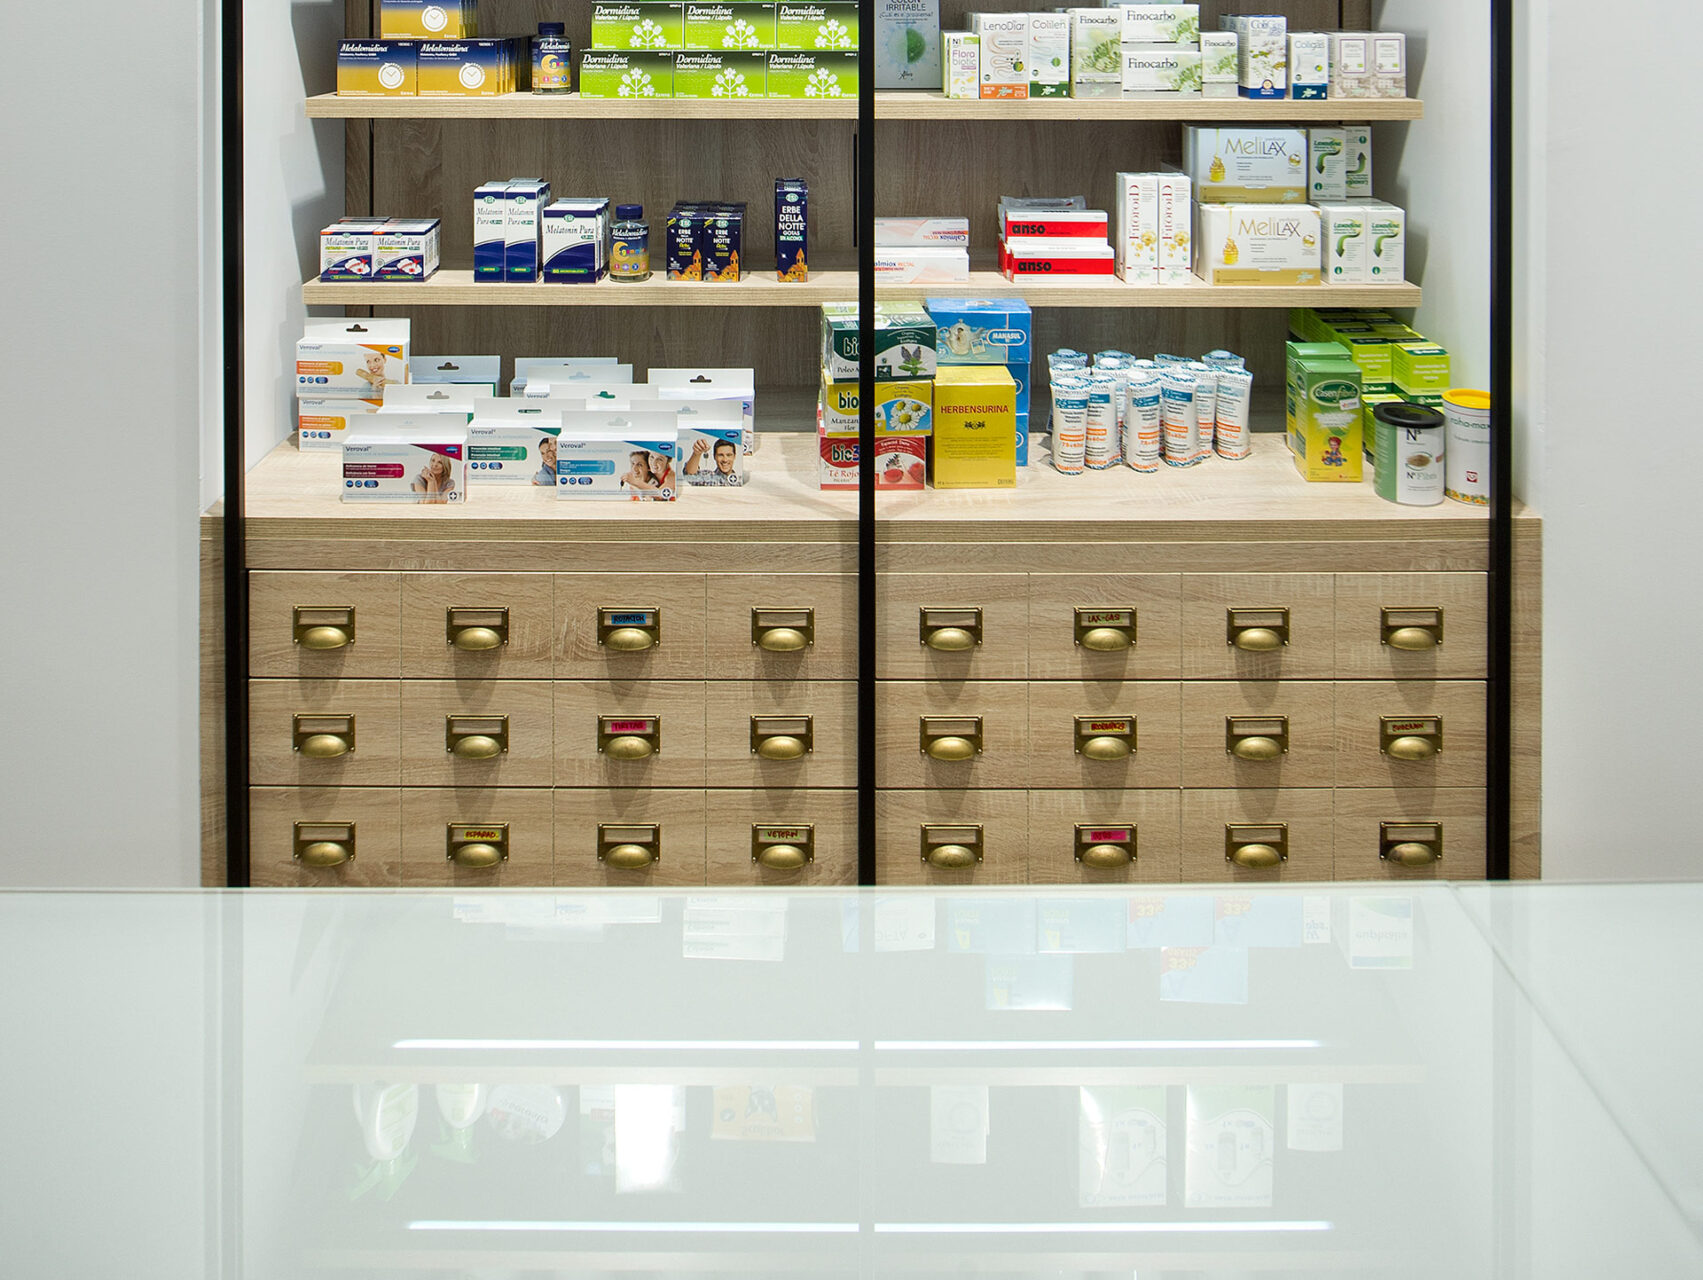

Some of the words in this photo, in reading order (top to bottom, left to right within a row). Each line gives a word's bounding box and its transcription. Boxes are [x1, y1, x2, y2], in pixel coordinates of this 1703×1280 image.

[595, 5, 640, 15] Dormidina
[687, 5, 733, 15] Dormidina
[780, 5, 825, 15] Dormidina
[886, 3, 926, 12] IRRITABLE
[1080, 15, 1118, 25] Finocarbo
[1127, 10, 1176, 21] Finocarbo
[582, 53, 629, 64] Dormidina
[676, 53, 722, 64] Dormidina
[769, 53, 815, 64] Dormidina
[952, 50, 976, 59] Flora
[1128, 58, 1179, 69] Finocarbo
[781, 206, 801, 214] ERBE
[779, 214, 804, 222] DELLA
[545, 224, 578, 235] Melatonin
[579, 224, 595, 235] Pura
[778, 223, 805, 231] NOTTE
[1011, 223, 1046, 234] anso
[1018, 261, 1052, 272] anso
[299, 344, 322, 352] Veroval
[838, 393, 860, 410] bio
[940, 404, 1009, 414] HERBENSURINA
